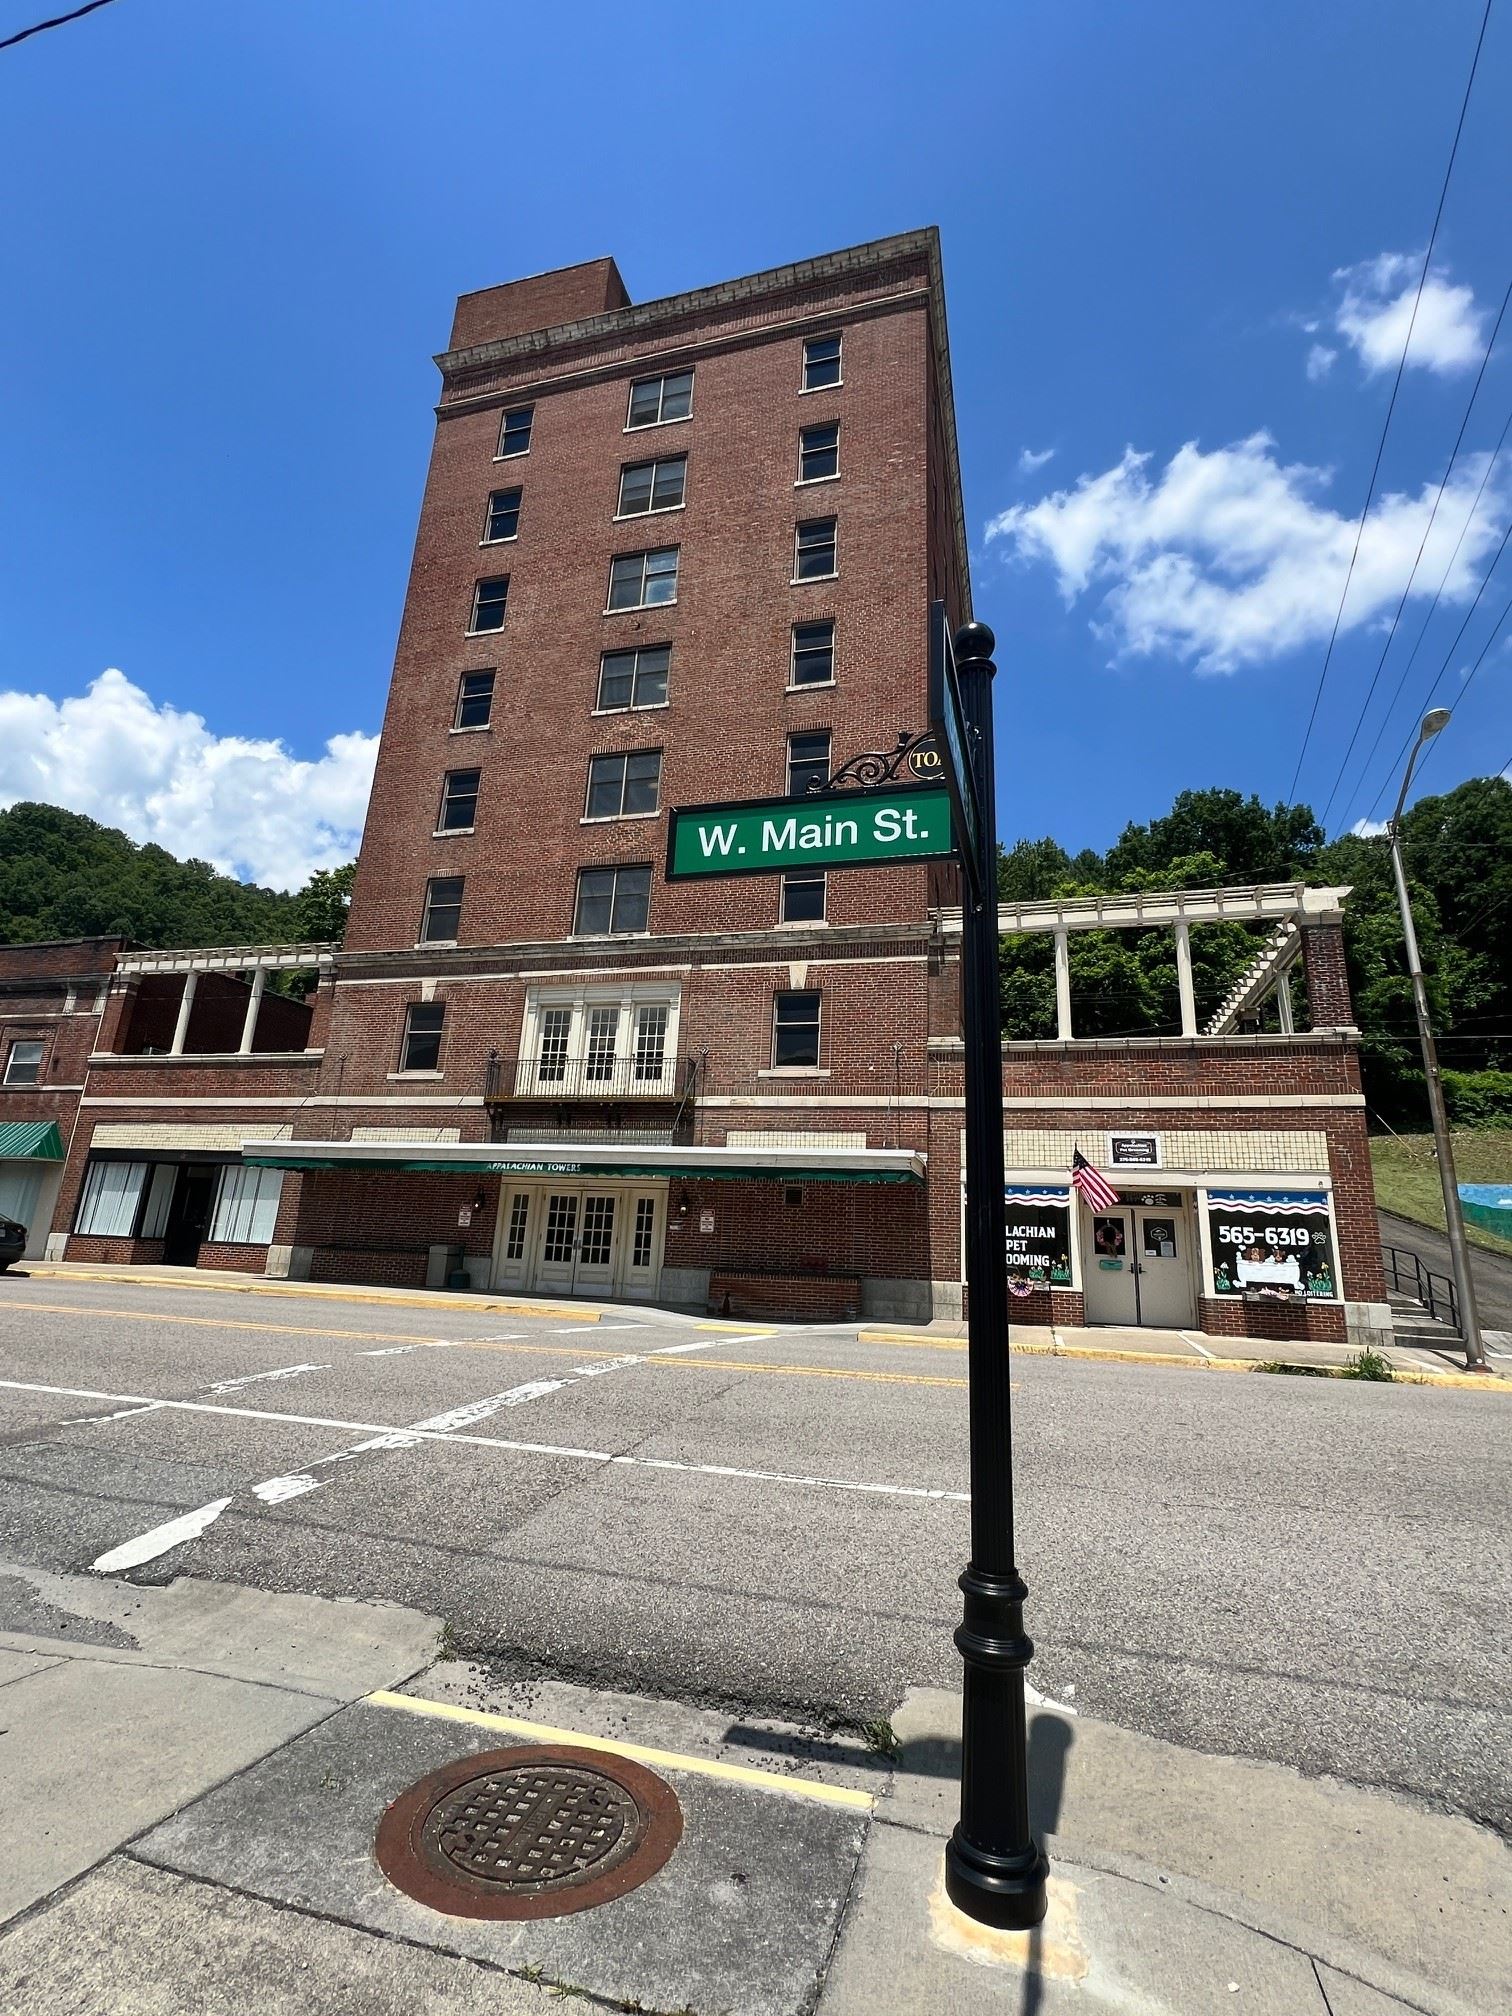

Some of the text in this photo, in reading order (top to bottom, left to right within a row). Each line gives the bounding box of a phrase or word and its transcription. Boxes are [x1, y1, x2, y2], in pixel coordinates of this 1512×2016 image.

[698, 808, 929, 857] W. Main St.
[486, 1162, 581, 1172] APPALACHIAN TOWERS
[1218, 1225, 1310, 1246] 565-6319
[1005, 1239, 1028, 1252] PET
